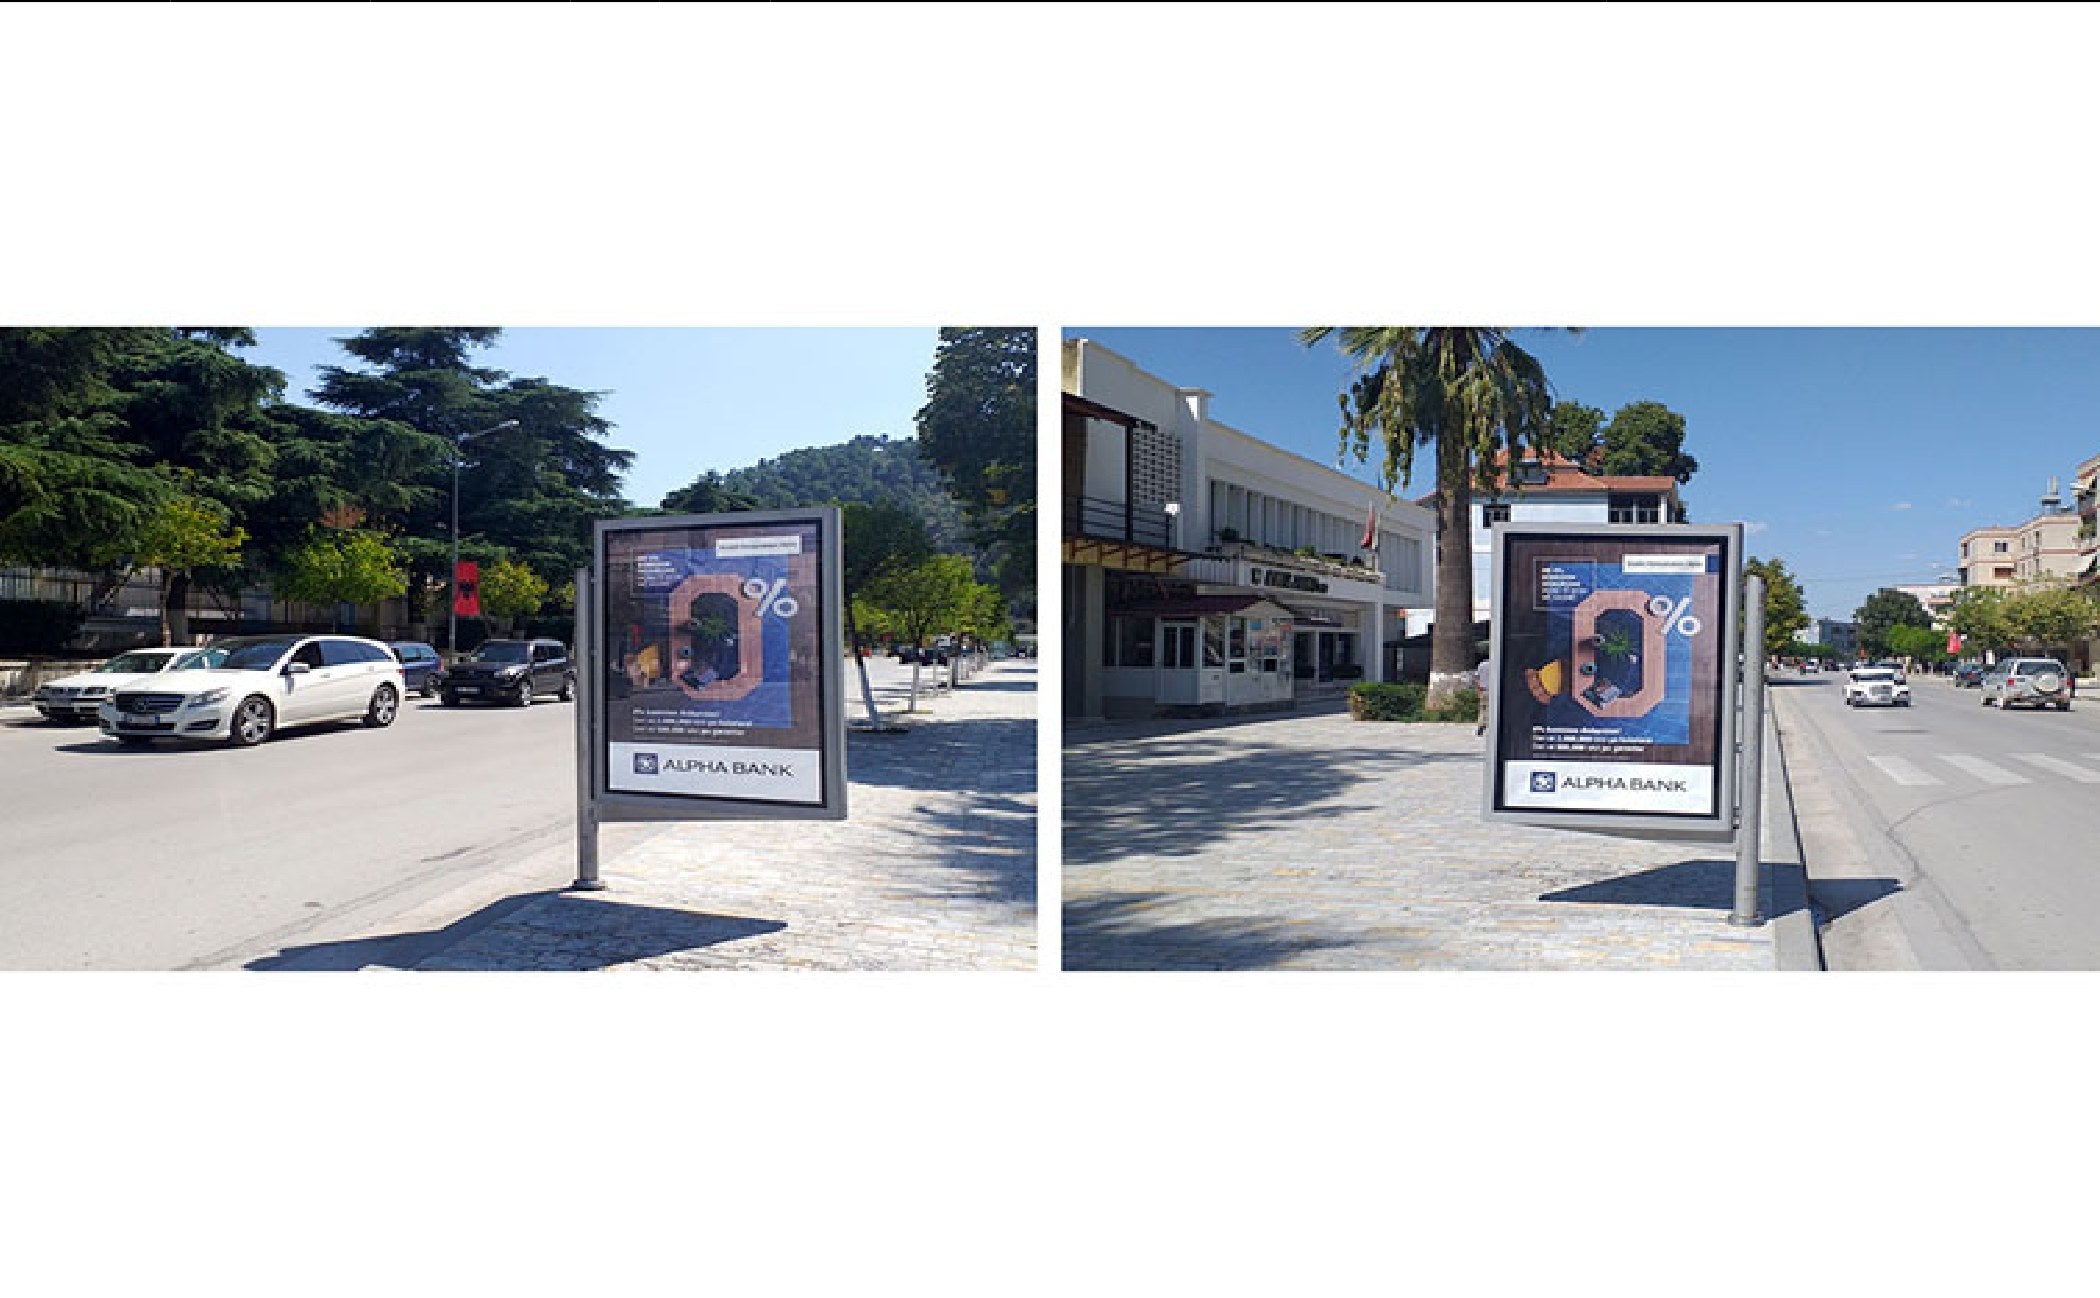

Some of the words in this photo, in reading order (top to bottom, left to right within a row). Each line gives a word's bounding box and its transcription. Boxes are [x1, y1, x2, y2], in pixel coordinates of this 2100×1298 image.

[662, 759, 728, 774] ALPHA
[732, 761, 795, 777] BANK
[1561, 776, 1626, 790] ALPHA
[1629, 778, 1689, 793] BANK
